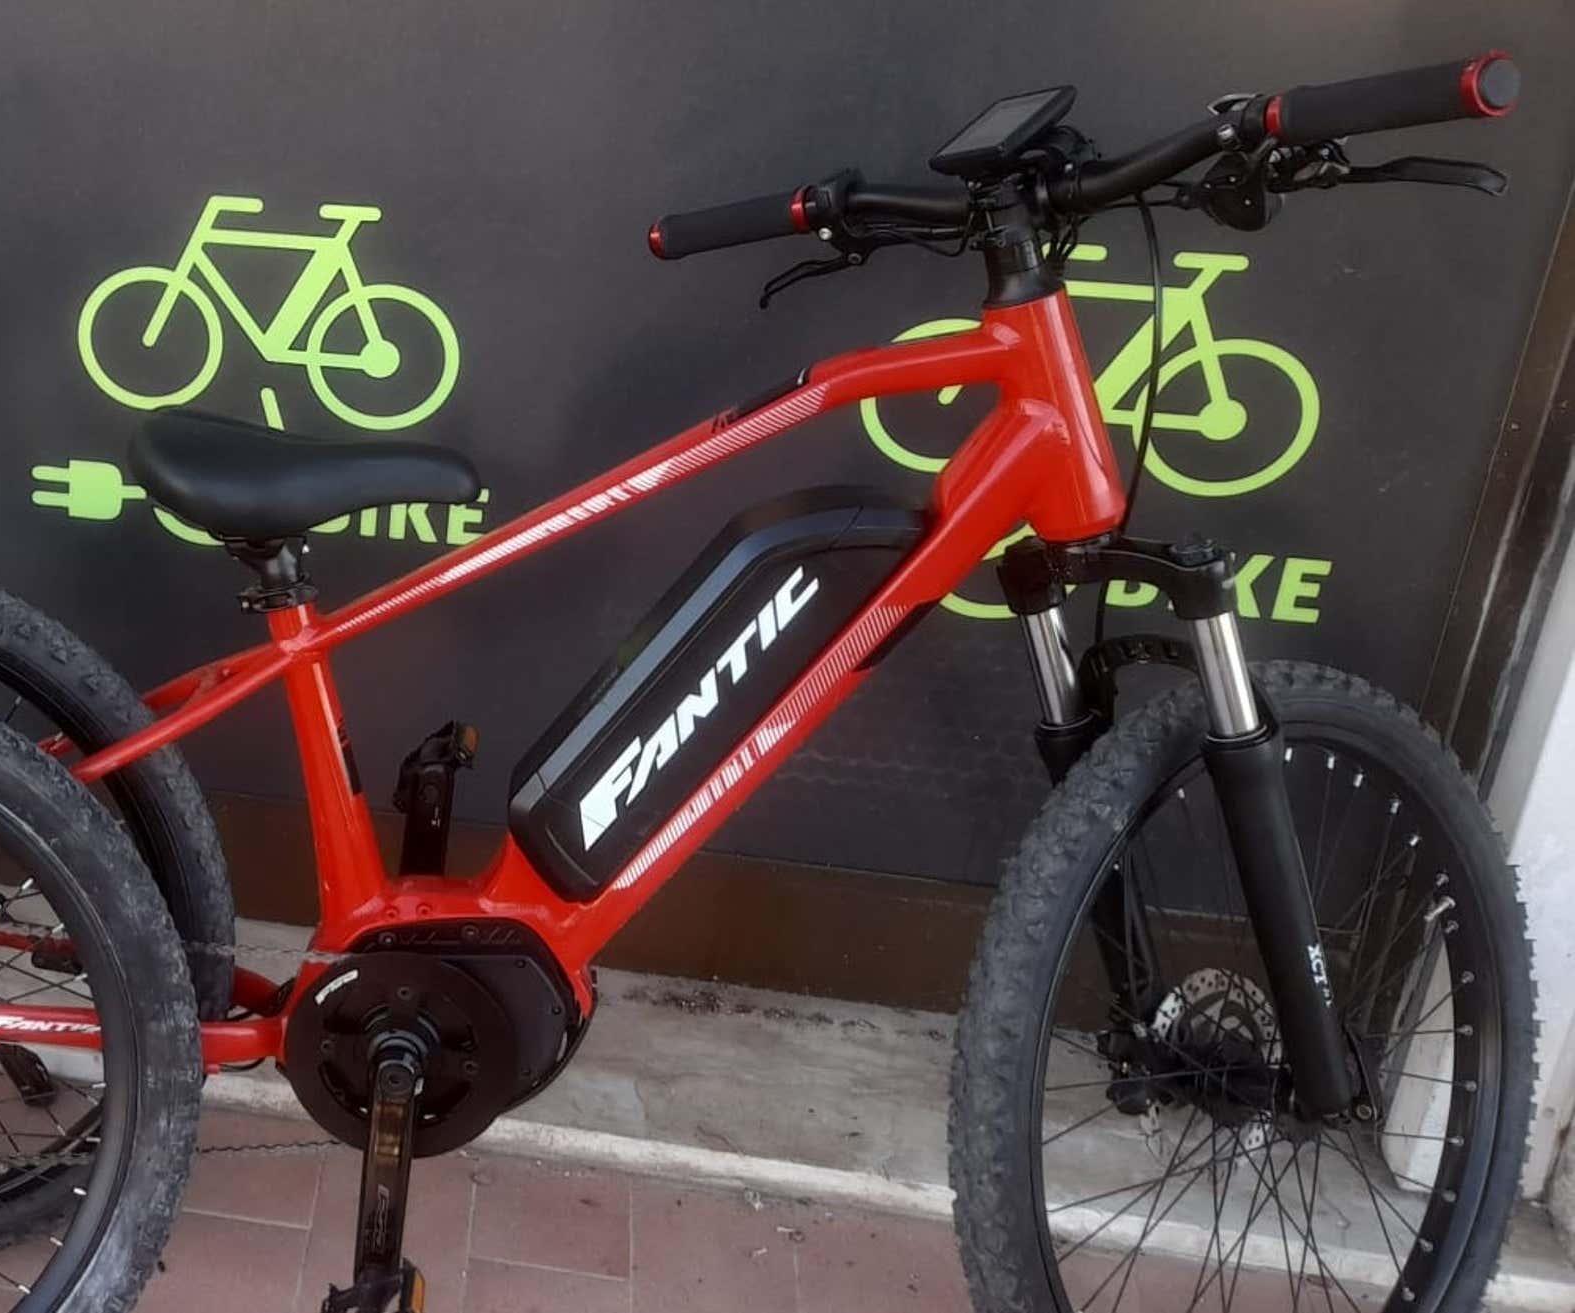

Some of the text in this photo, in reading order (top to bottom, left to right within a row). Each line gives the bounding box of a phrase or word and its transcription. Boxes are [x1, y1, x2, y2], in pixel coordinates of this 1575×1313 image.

[309, 487, 491, 545] IKE
[1104, 554, 1333, 624] KE
[579, 565, 819, 851] FANTIC
